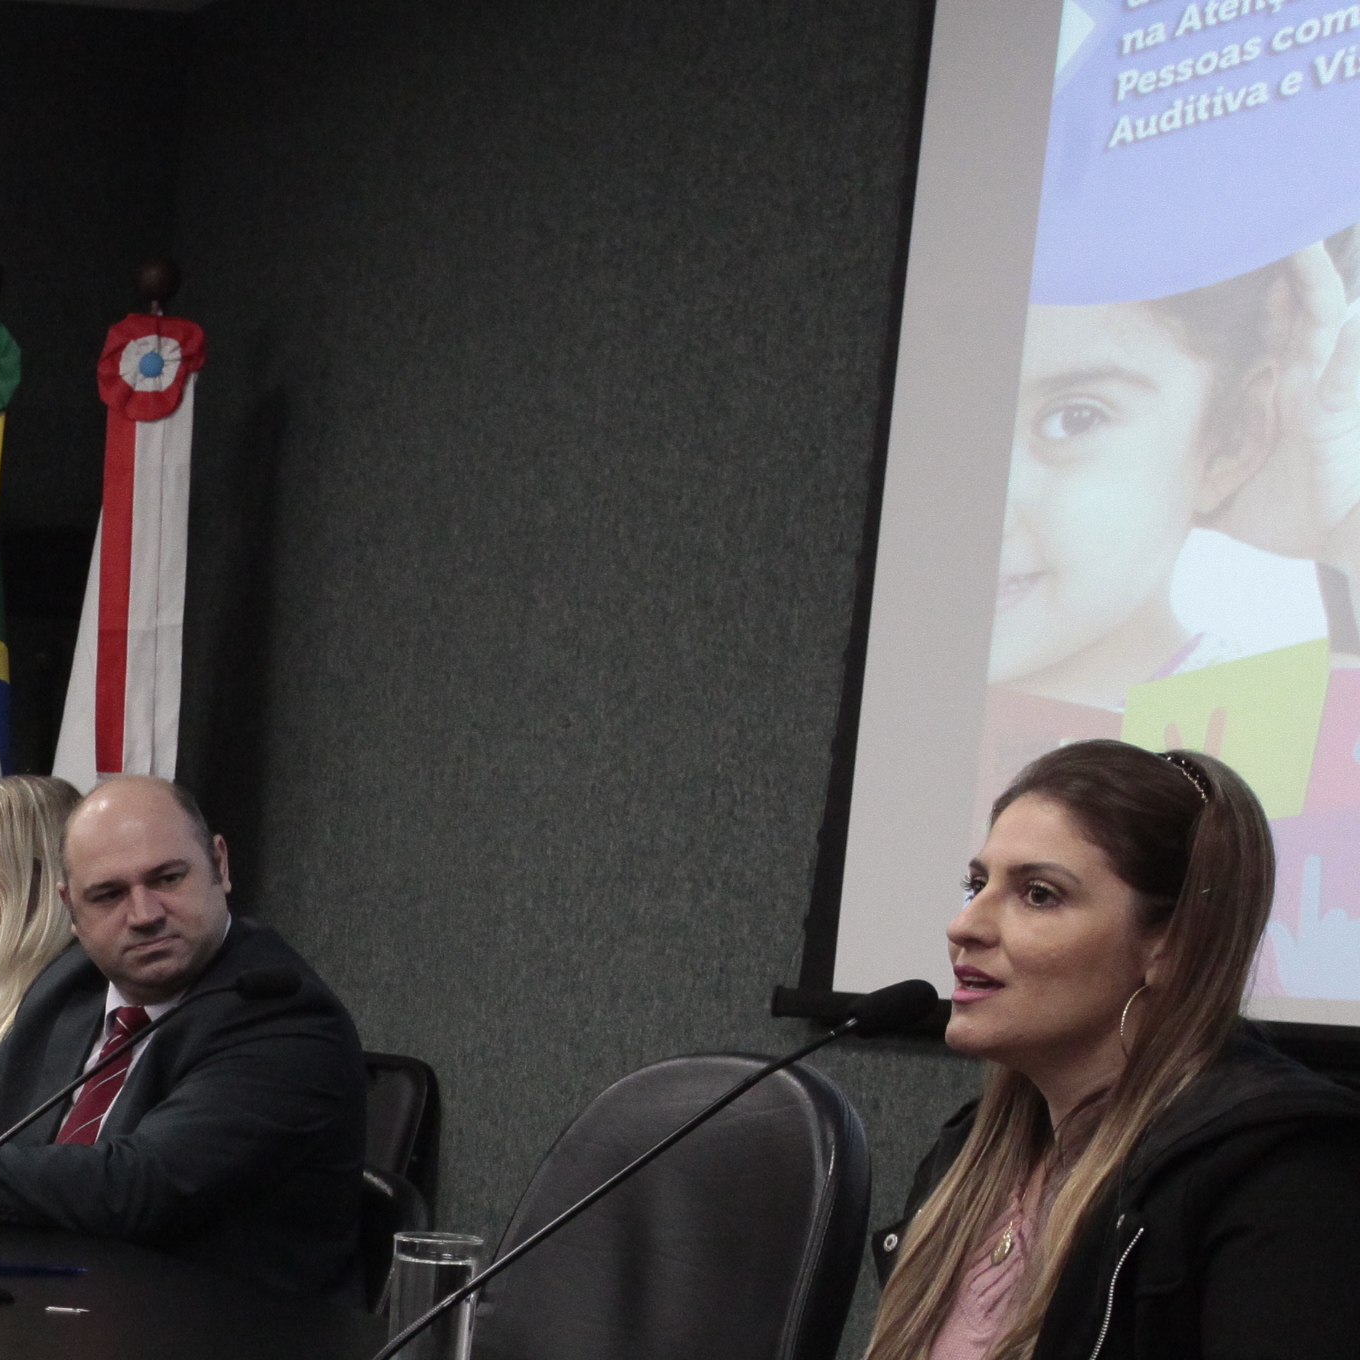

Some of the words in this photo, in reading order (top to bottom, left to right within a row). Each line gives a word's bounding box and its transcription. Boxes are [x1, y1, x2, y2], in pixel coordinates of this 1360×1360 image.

[1116, 36, 1264, 102] Pessoas
[1271, 4, 1360, 52] com
[1121, 22, 1167, 54] na
[1107, 81, 1269, 149] Auditiva
[1280, 70, 1304, 96] e
